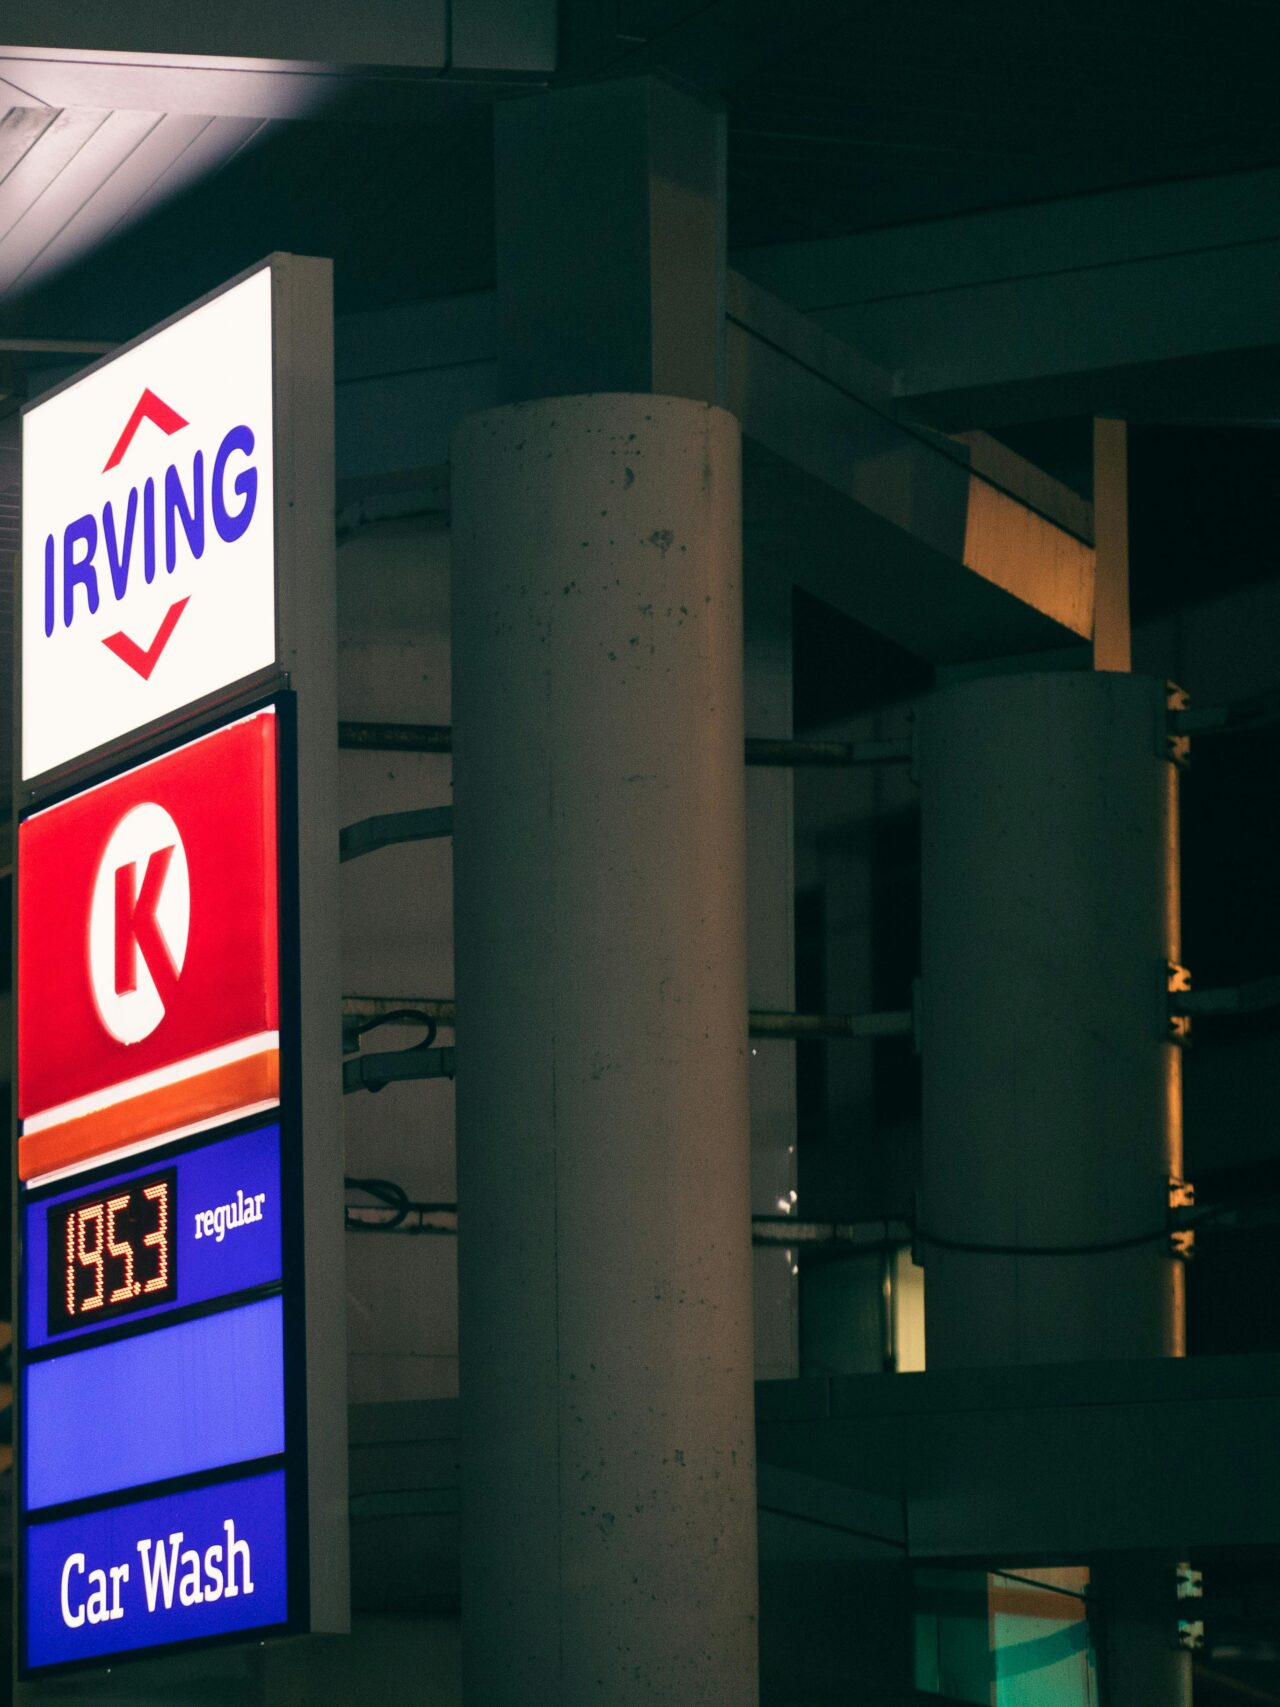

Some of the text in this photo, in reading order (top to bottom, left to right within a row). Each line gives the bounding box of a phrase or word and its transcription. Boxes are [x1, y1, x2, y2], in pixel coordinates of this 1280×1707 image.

[44, 424, 259, 638] IRVING
[114, 843, 183, 1014] K
[66, 1182, 169, 1315] 195.3
[194, 1189, 266, 1243] regular
[60, 1518, 255, 1629] Car Wash
